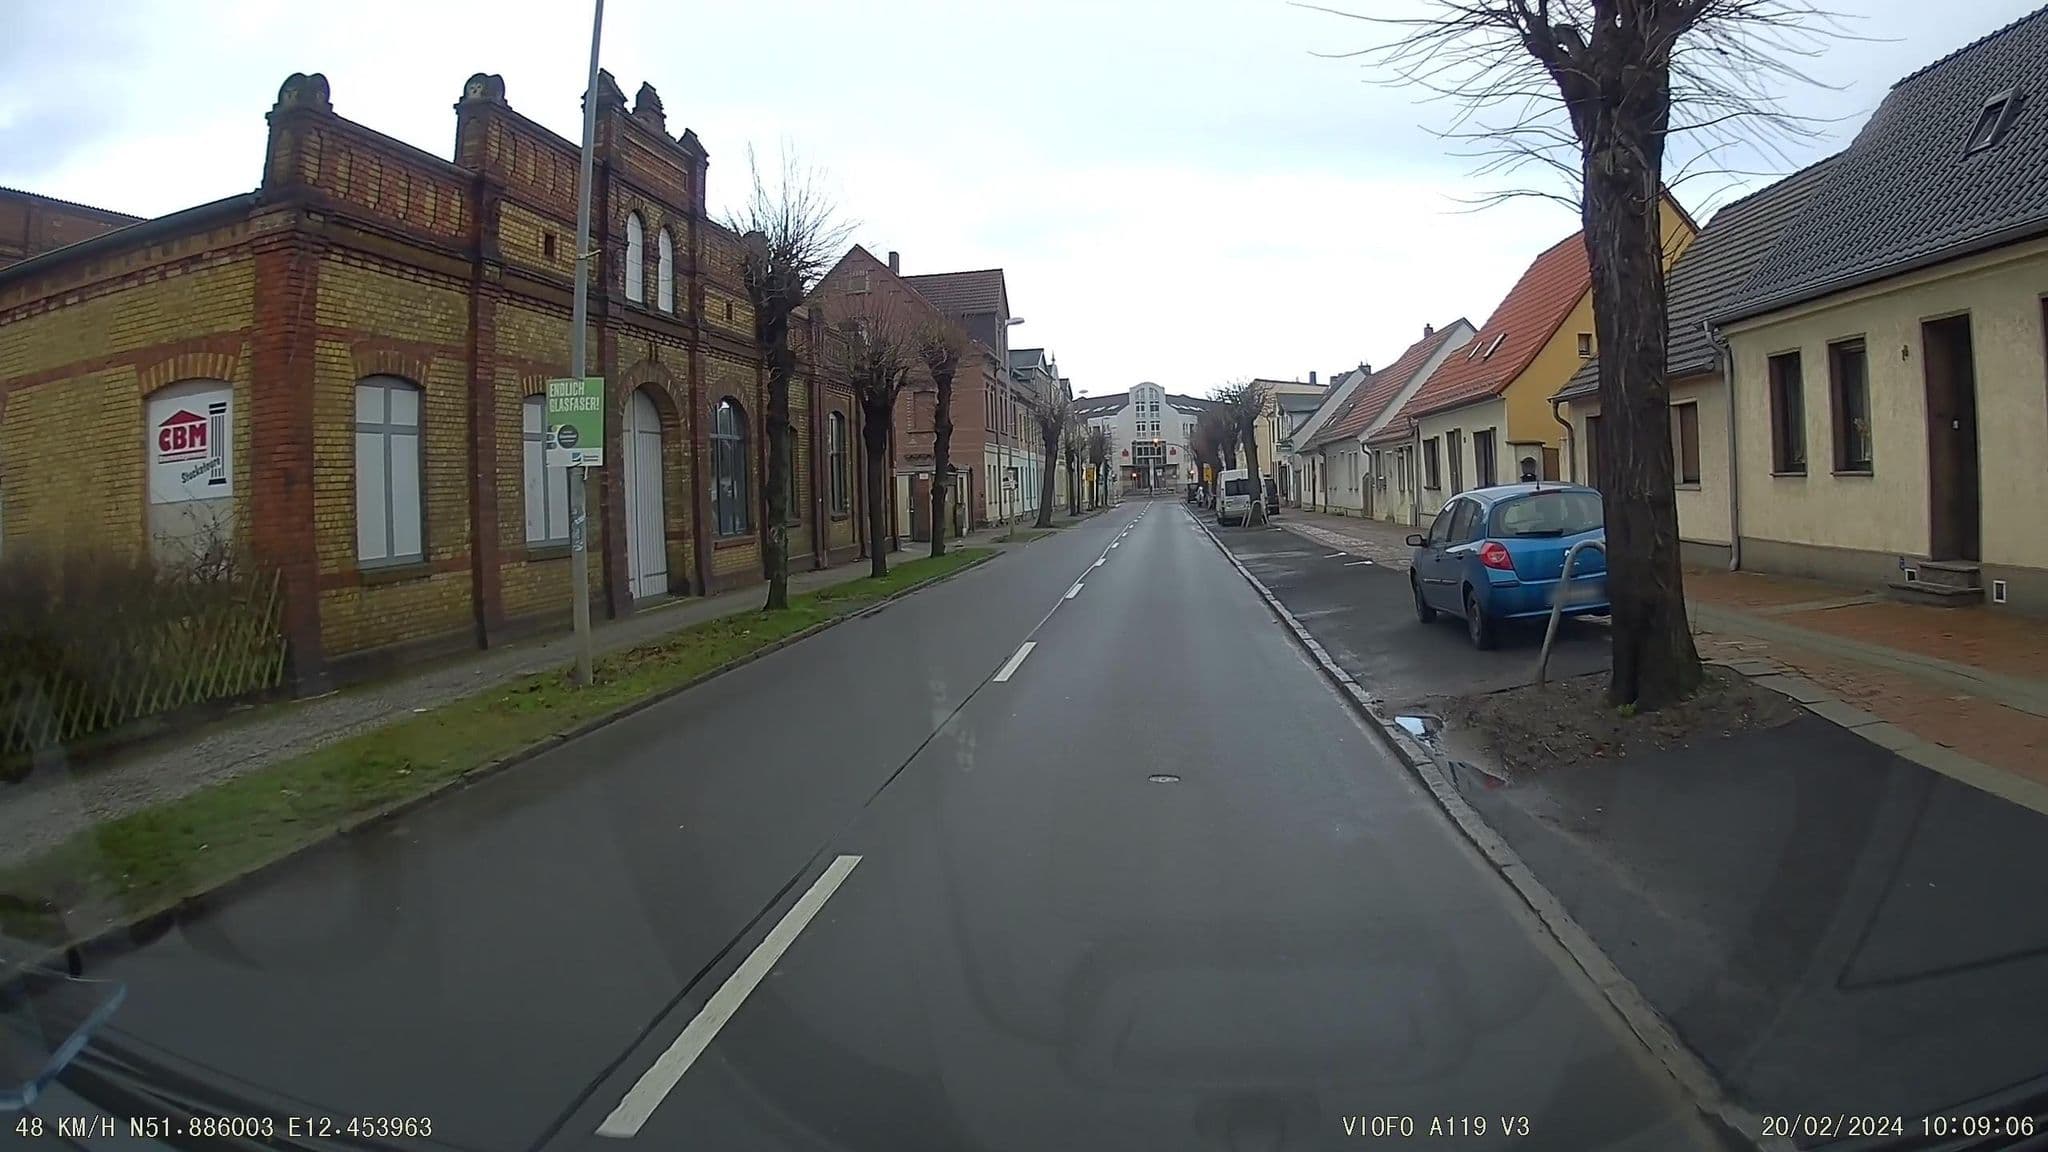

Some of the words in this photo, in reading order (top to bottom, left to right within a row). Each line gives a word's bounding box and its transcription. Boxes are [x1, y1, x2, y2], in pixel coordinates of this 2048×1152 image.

[550, 382, 585, 396] ENDLICH
[549, 396, 600, 412] GLASFASER!
[160, 423, 207, 451] CBM
